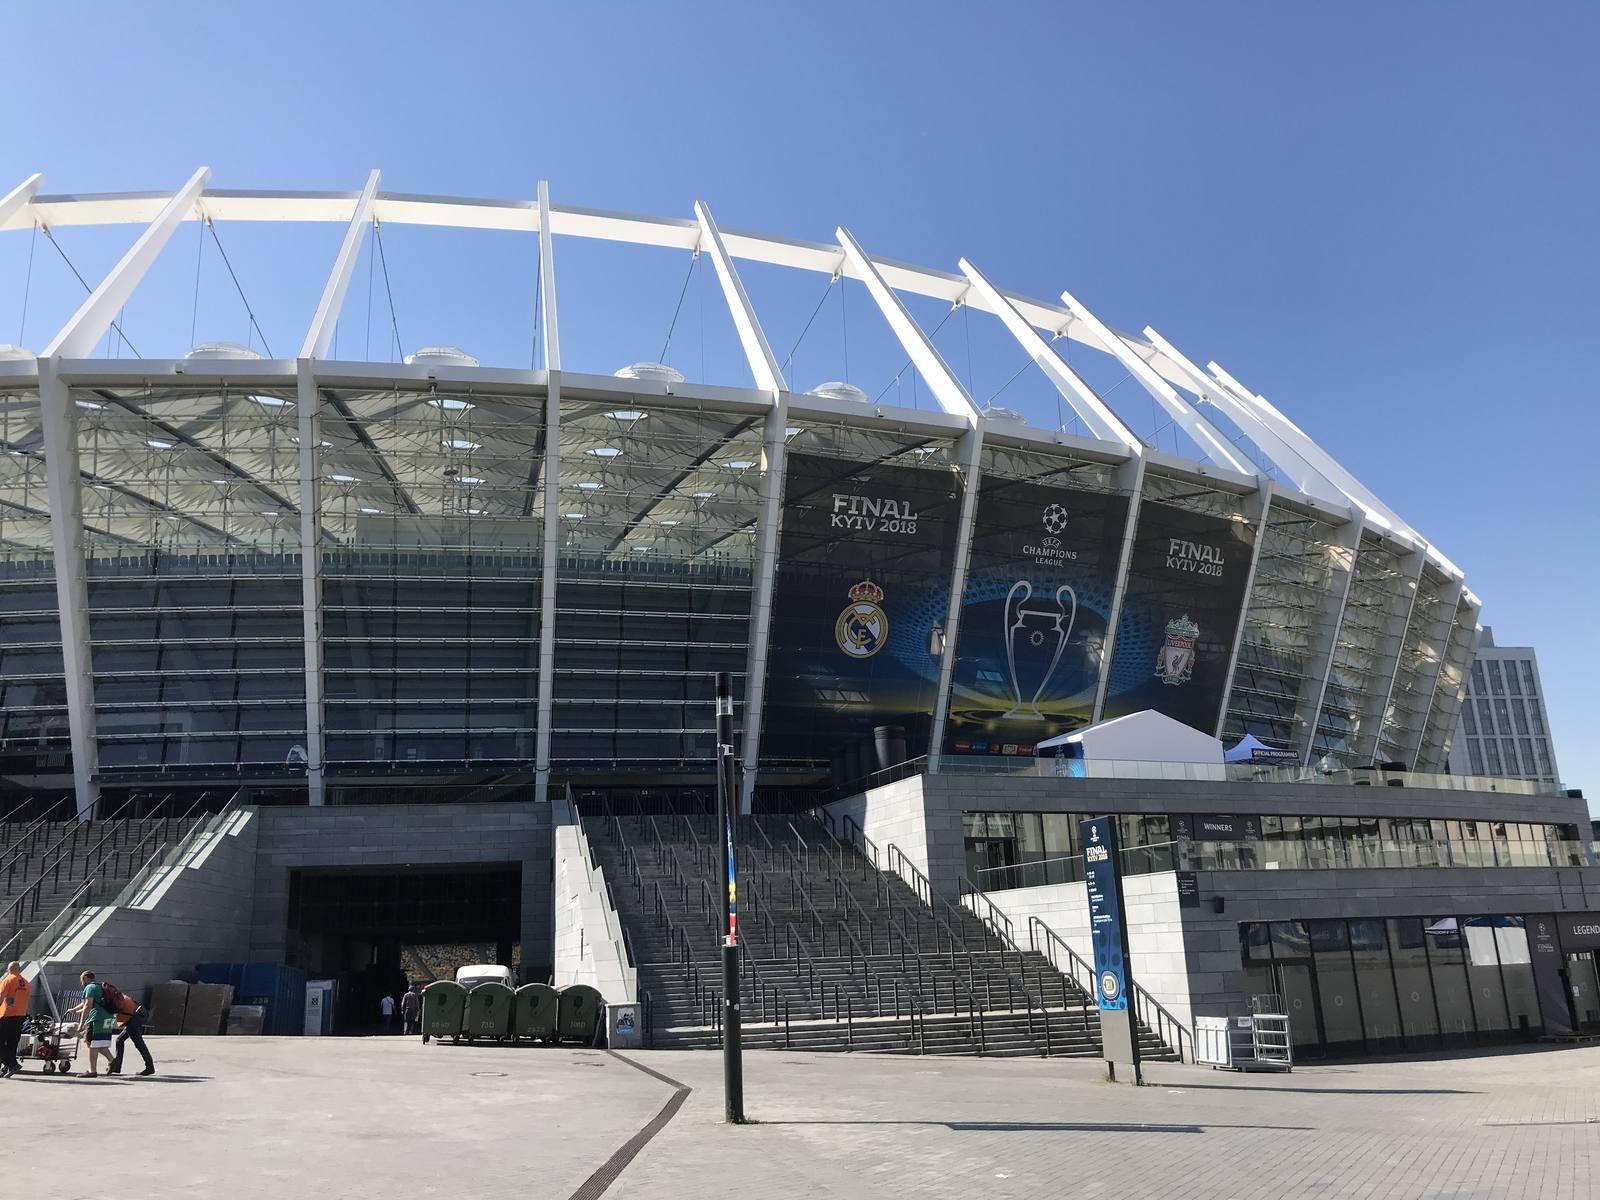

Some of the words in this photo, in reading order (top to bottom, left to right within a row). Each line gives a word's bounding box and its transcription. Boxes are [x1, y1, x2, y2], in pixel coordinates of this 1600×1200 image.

[832, 493, 918, 520] FINAL
[830, 514, 877, 531] KYIV
[879, 518, 917, 534] 2018
[1042, 537, 1060, 549] UEFA
[1022, 544, 1078, 560] CHAMPIONS
[1169, 537, 1225, 565] FINAL
[1035, 556, 1064, 567] LEAGUE
[1166, 555, 1198, 572] KYIV
[1198, 562, 1223, 577] 2018
[1203, 822, 1233, 832] WINNERS
[1086, 845, 1107, 857] FINAL
[1572, 925, 1600, 935] LEGEND
